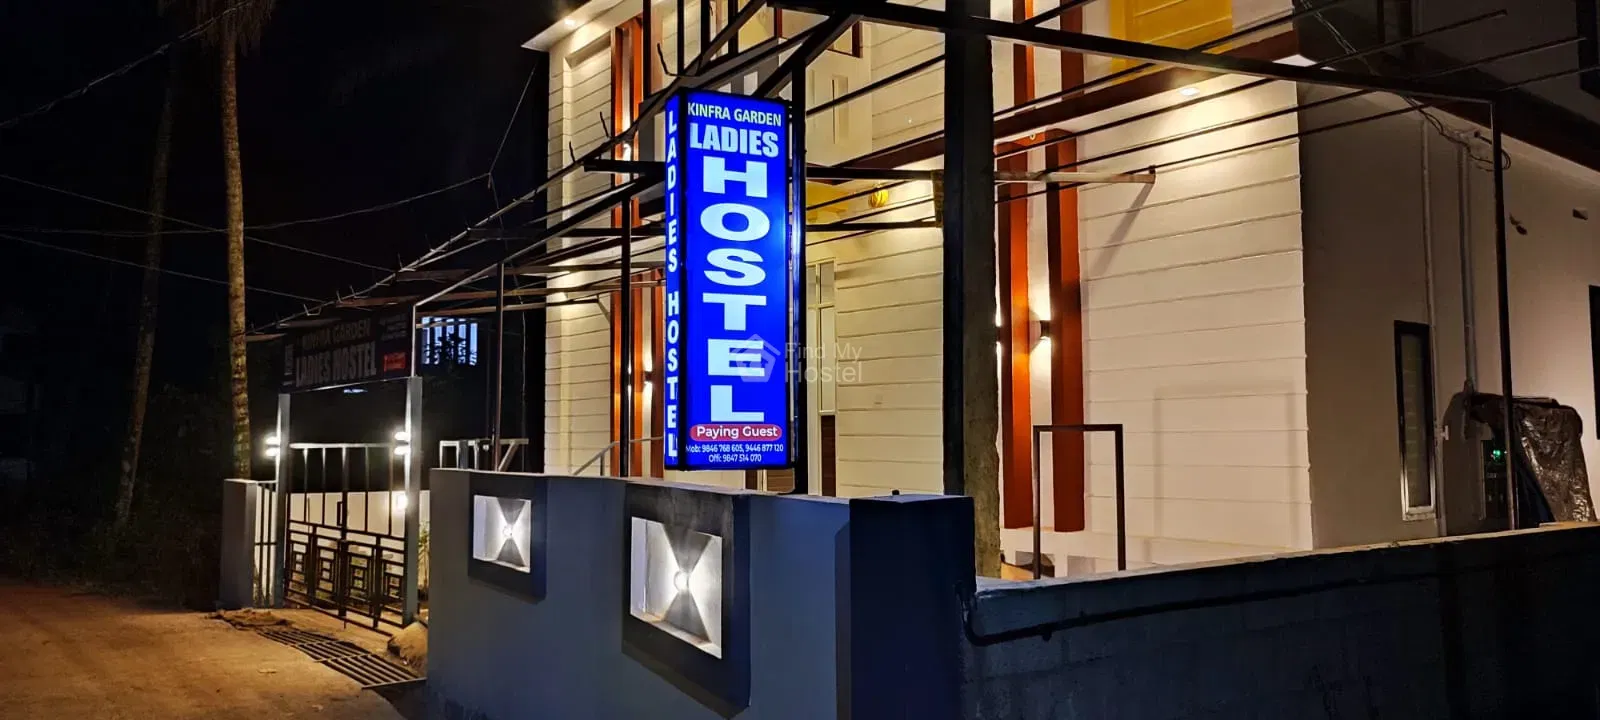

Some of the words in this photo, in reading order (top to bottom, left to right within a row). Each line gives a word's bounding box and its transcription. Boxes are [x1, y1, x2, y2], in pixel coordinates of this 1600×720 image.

[688, 102, 731, 120] KINFRA
[734, 109, 782, 126] GARDEN
[690, 123, 779, 158] LADIES
[667, 110, 678, 272] LADIES
[700, 156, 770, 422] HOSTEL
[667, 291, 679, 457] HOSTEL
[696, 425, 739, 440] Paying
[742, 425, 778, 437] Guest
[702, 444, 719, 453] 9846
[745, 444, 761, 453] 9446
[761, 444, 773, 453] 877
[774, 444, 784, 452] 120
[722, 454, 738, 463] 9847
[750, 454, 762, 463] 070
